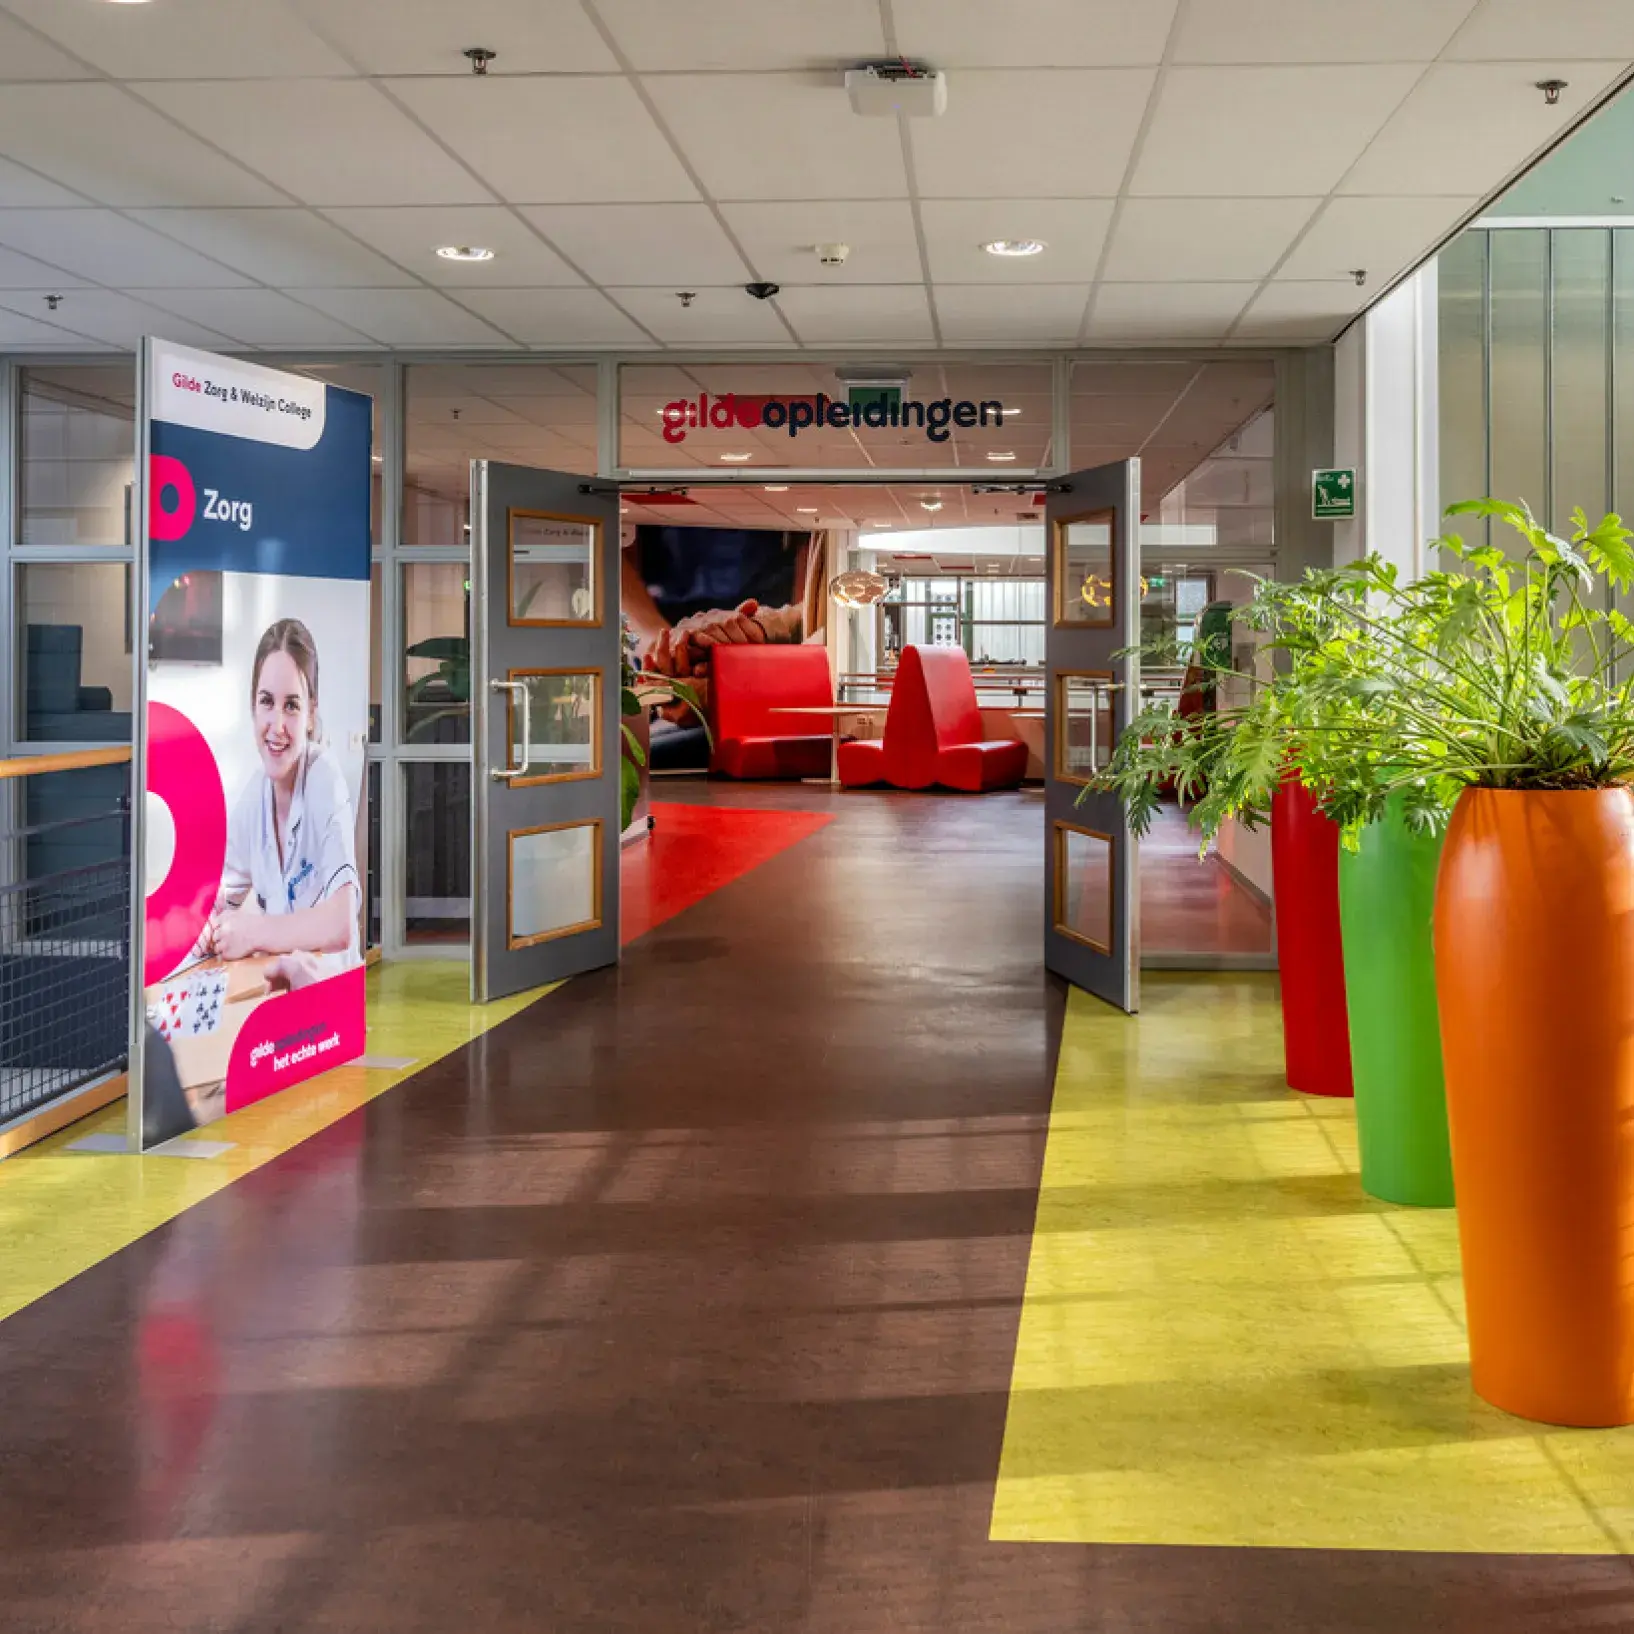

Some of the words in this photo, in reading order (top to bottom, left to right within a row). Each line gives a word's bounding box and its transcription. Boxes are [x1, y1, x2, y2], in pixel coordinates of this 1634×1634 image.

[171, 372, 201, 393] Gilde
[204, 380, 228, 401] Zorg
[230, 386, 239, 401] &
[240, 388, 277, 411] Welzijn
[278, 398, 311, 420] College
[203, 488, 253, 531] Zorg
[273, 1055, 289, 1072] het
